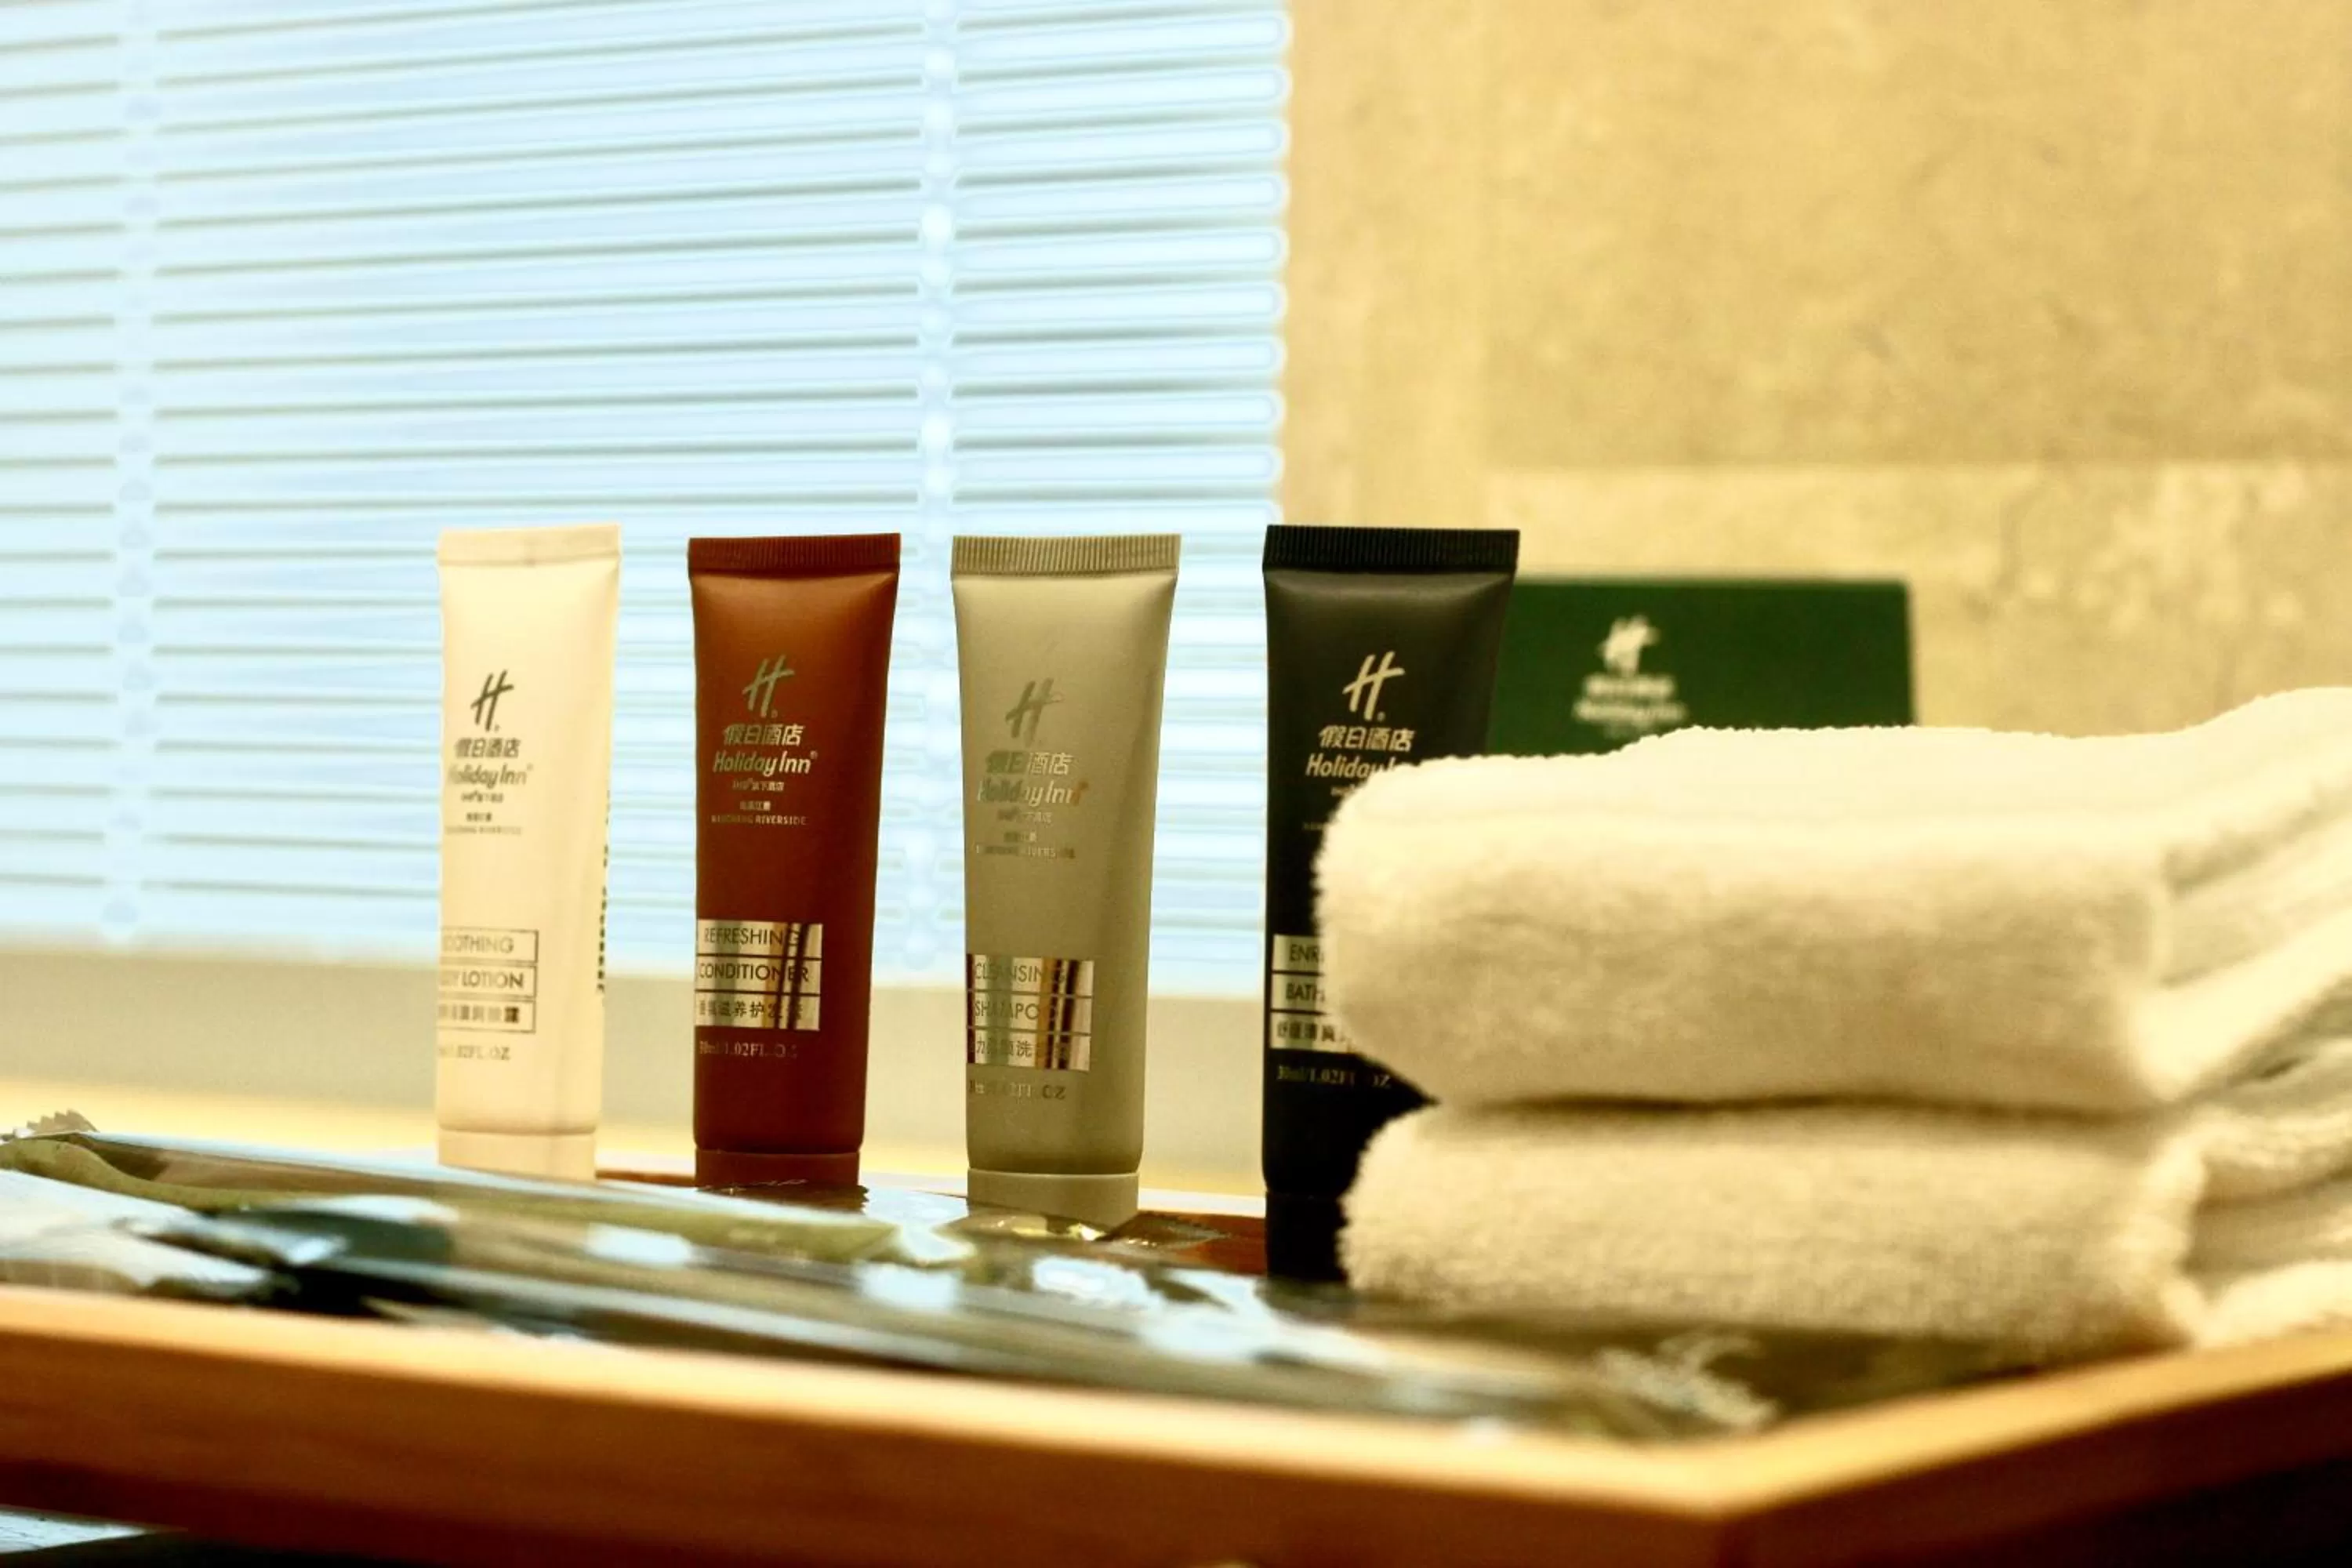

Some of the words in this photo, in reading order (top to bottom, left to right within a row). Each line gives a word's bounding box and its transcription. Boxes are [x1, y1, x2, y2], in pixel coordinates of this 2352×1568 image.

[723, 722, 805, 746] 假日酒店
[1319, 724, 1415, 752] 假日酒店
[712, 750, 775, 778] Holiday
[779, 750, 811, 775] Inn
[462, 969, 524, 989] LOTION
[699, 962, 809, 982] CONDITIONER
